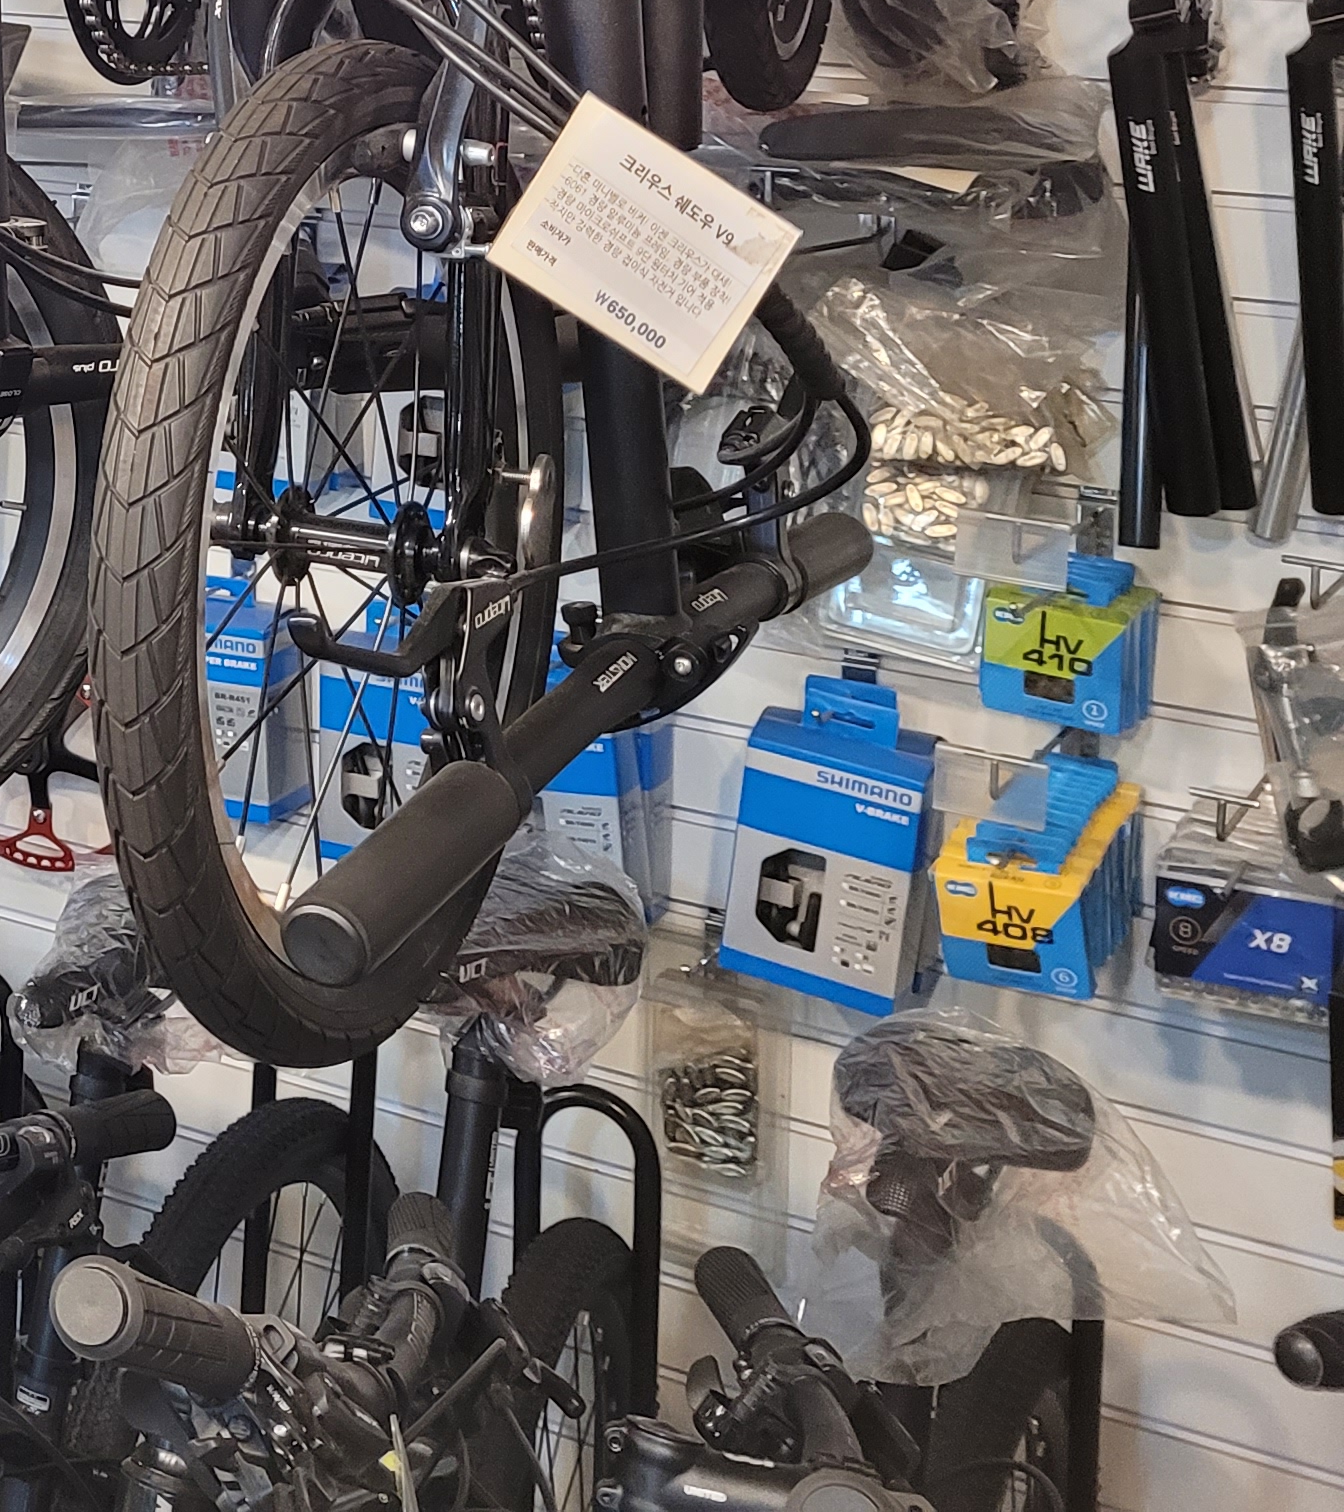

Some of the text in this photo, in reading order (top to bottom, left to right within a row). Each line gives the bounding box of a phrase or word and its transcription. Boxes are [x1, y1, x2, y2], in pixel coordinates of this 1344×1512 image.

[1129, 120, 1156, 193] WAKE
[1300, 112, 1320, 186] WAKE
[619, 154, 734, 250] 크리우스 쉐도우 V9
[592, 651, 638, 692] MONSTER
[1022, 649, 1093, 677] 410
[817, 770, 912, 807] SHIMANO
[855, 803, 910, 826] V-BRAKE
[976, 920, 1054, 945] 408
[1248, 929, 1292, 954] X8
[459, 957, 488, 983] UCT
[69, 986, 99, 1011] UCT
